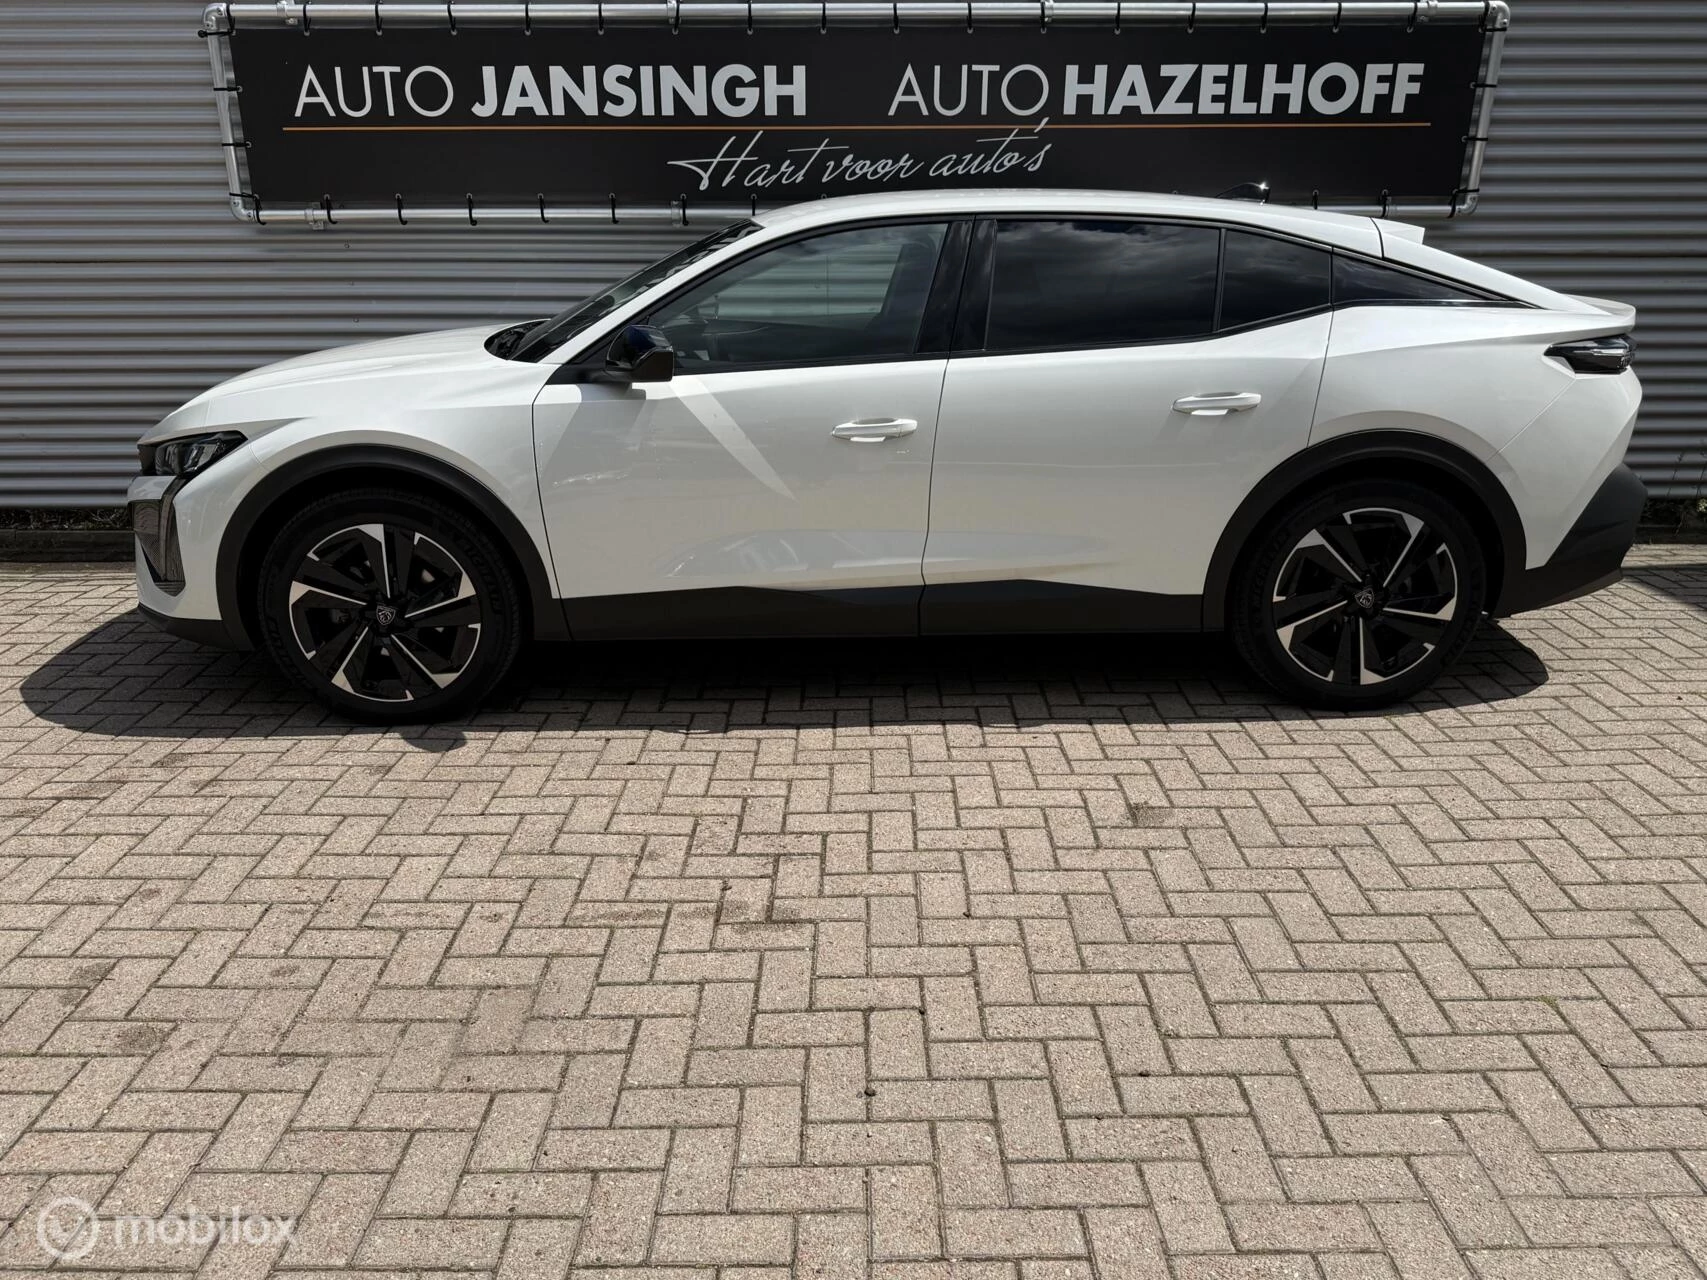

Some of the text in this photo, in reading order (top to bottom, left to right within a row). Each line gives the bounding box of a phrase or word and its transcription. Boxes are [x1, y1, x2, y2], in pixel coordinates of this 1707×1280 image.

[295, 64, 806, 117] AUTO JANSINGH
[888, 62, 1425, 116] AUTO HAZELHOFF
[667, 116, 1053, 190] Hart voor auto's
